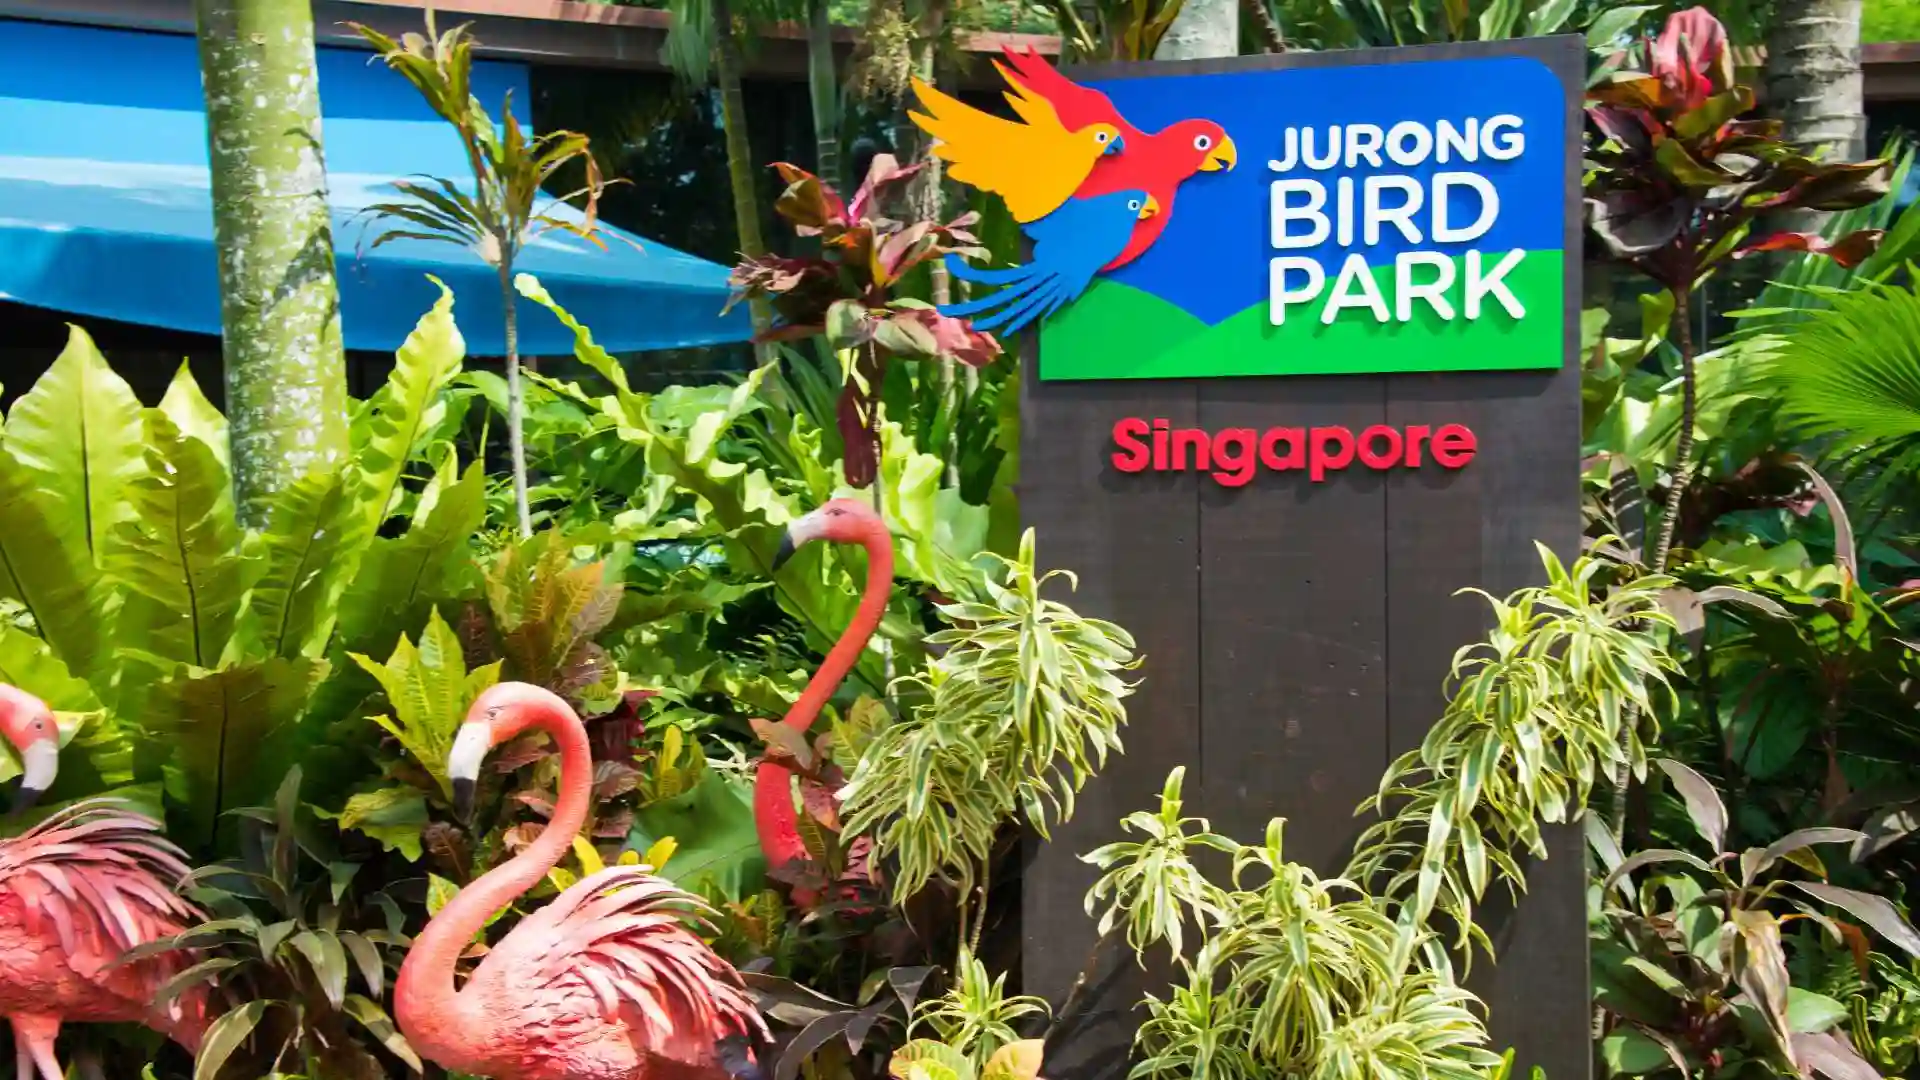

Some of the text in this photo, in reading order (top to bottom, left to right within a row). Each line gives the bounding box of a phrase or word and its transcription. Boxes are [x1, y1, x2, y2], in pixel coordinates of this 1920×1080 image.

[1268, 114, 1525, 172] JURONG
[1270, 171, 1500, 249] BIRD
[1269, 248, 1526, 326] PARK
[1111, 417, 1478, 487] Singapore
